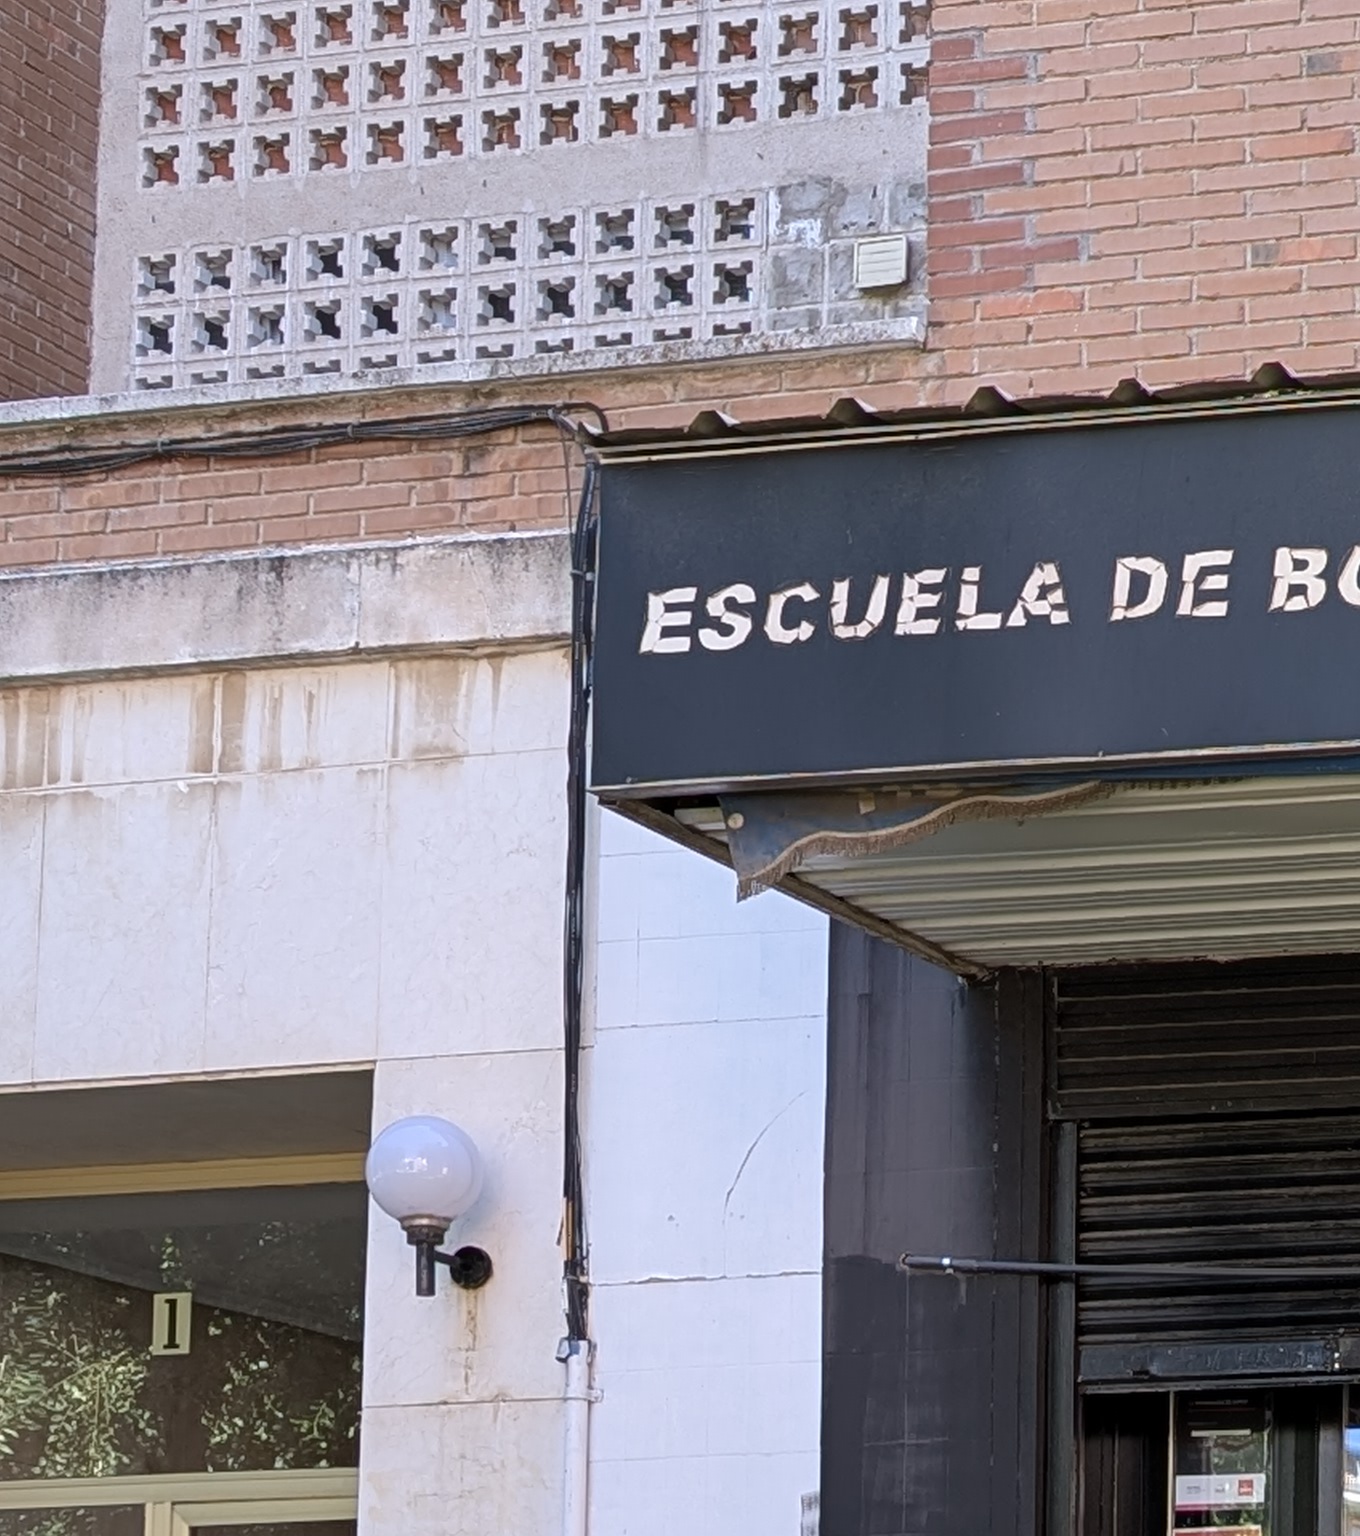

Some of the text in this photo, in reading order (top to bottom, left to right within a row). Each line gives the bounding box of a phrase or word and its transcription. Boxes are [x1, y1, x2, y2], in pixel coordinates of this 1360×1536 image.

[639, 563, 1070, 654] ESCUELA
[1109, 549, 1234, 622] DE
[162, 1298, 180, 1350] 1
